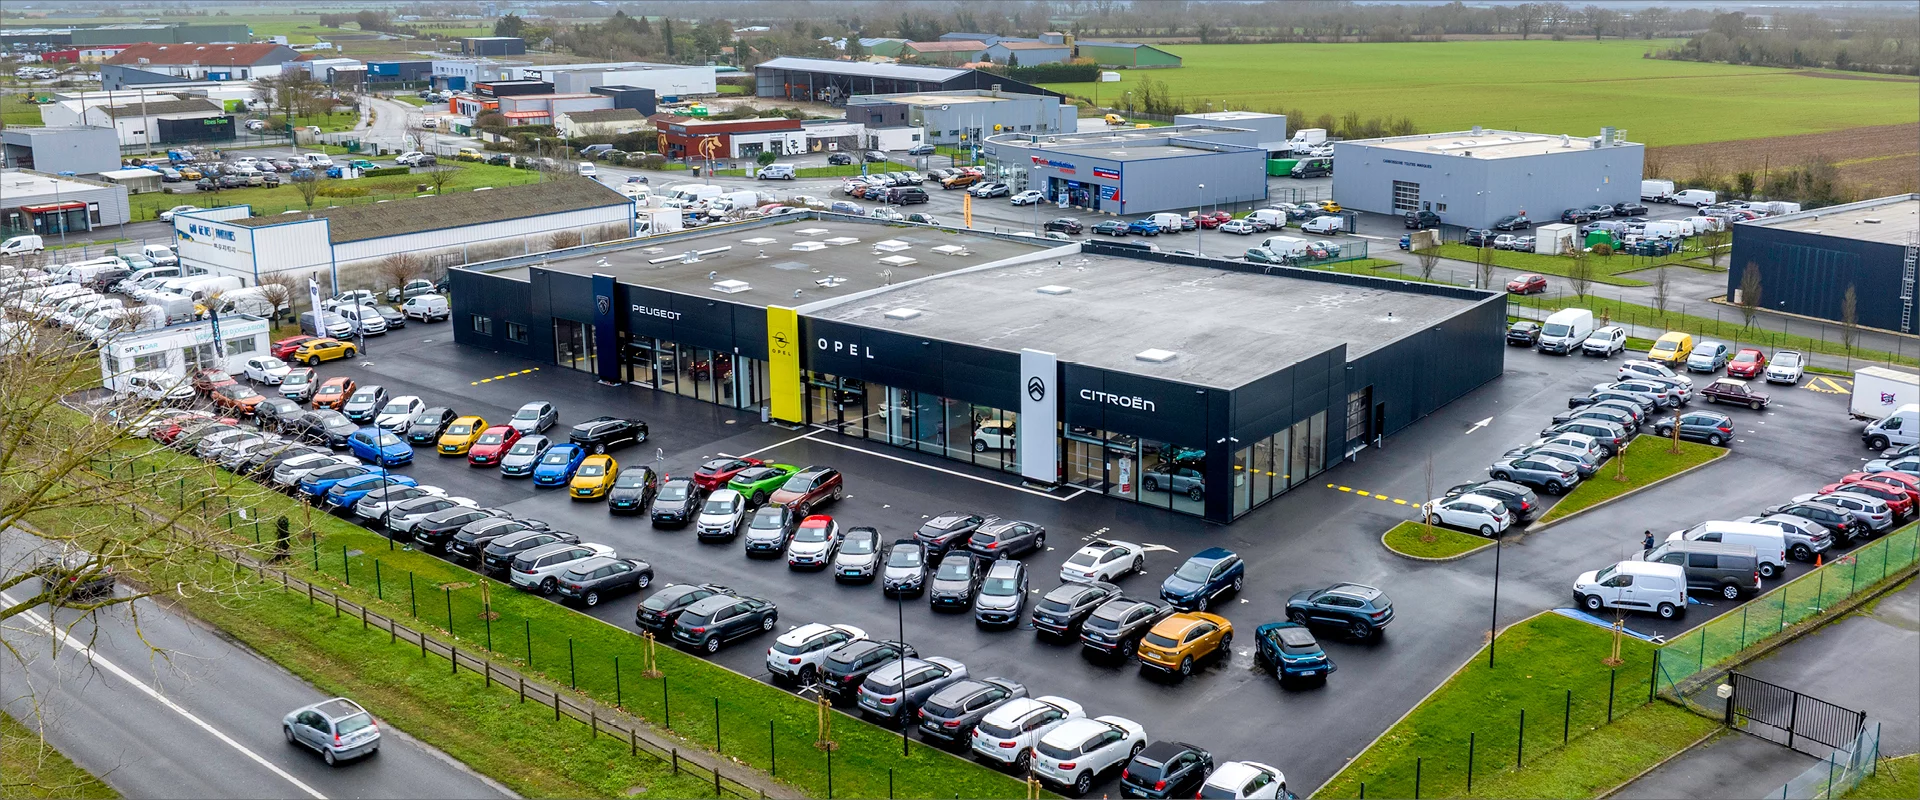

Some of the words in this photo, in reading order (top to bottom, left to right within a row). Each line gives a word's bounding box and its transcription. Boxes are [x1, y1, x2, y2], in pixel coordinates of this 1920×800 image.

[632, 304, 681, 320] PEUGEOT
[230, 323, 265, 335] D'OCCASION
[125, 343, 158, 353] SPOTICAR
[818, 337, 874, 359] OPEL
[1080, 389, 1155, 412] CITROËN
